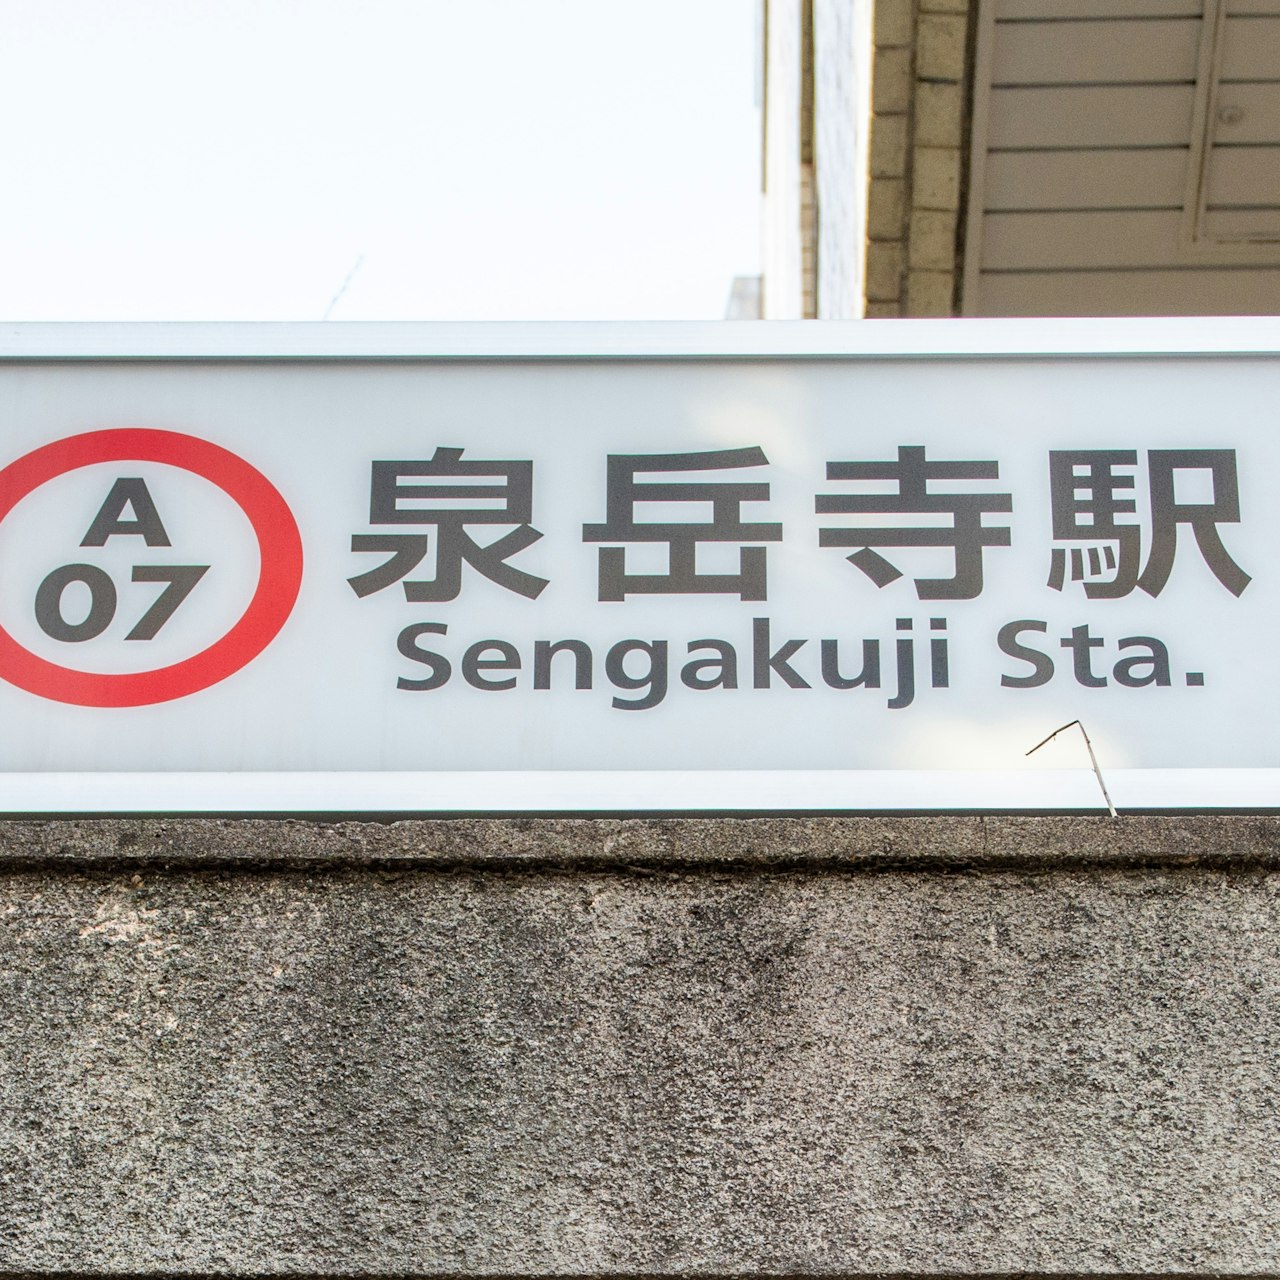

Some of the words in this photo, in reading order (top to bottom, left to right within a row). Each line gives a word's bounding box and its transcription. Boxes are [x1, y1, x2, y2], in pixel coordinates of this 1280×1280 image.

[79, 476, 172, 548] A
[346, 444, 1253, 603] 泉岳寺駅
[33, 562, 212, 643] 07
[395, 617, 951, 711] Sengakuji
[995, 619, 1206, 690] Sta.
